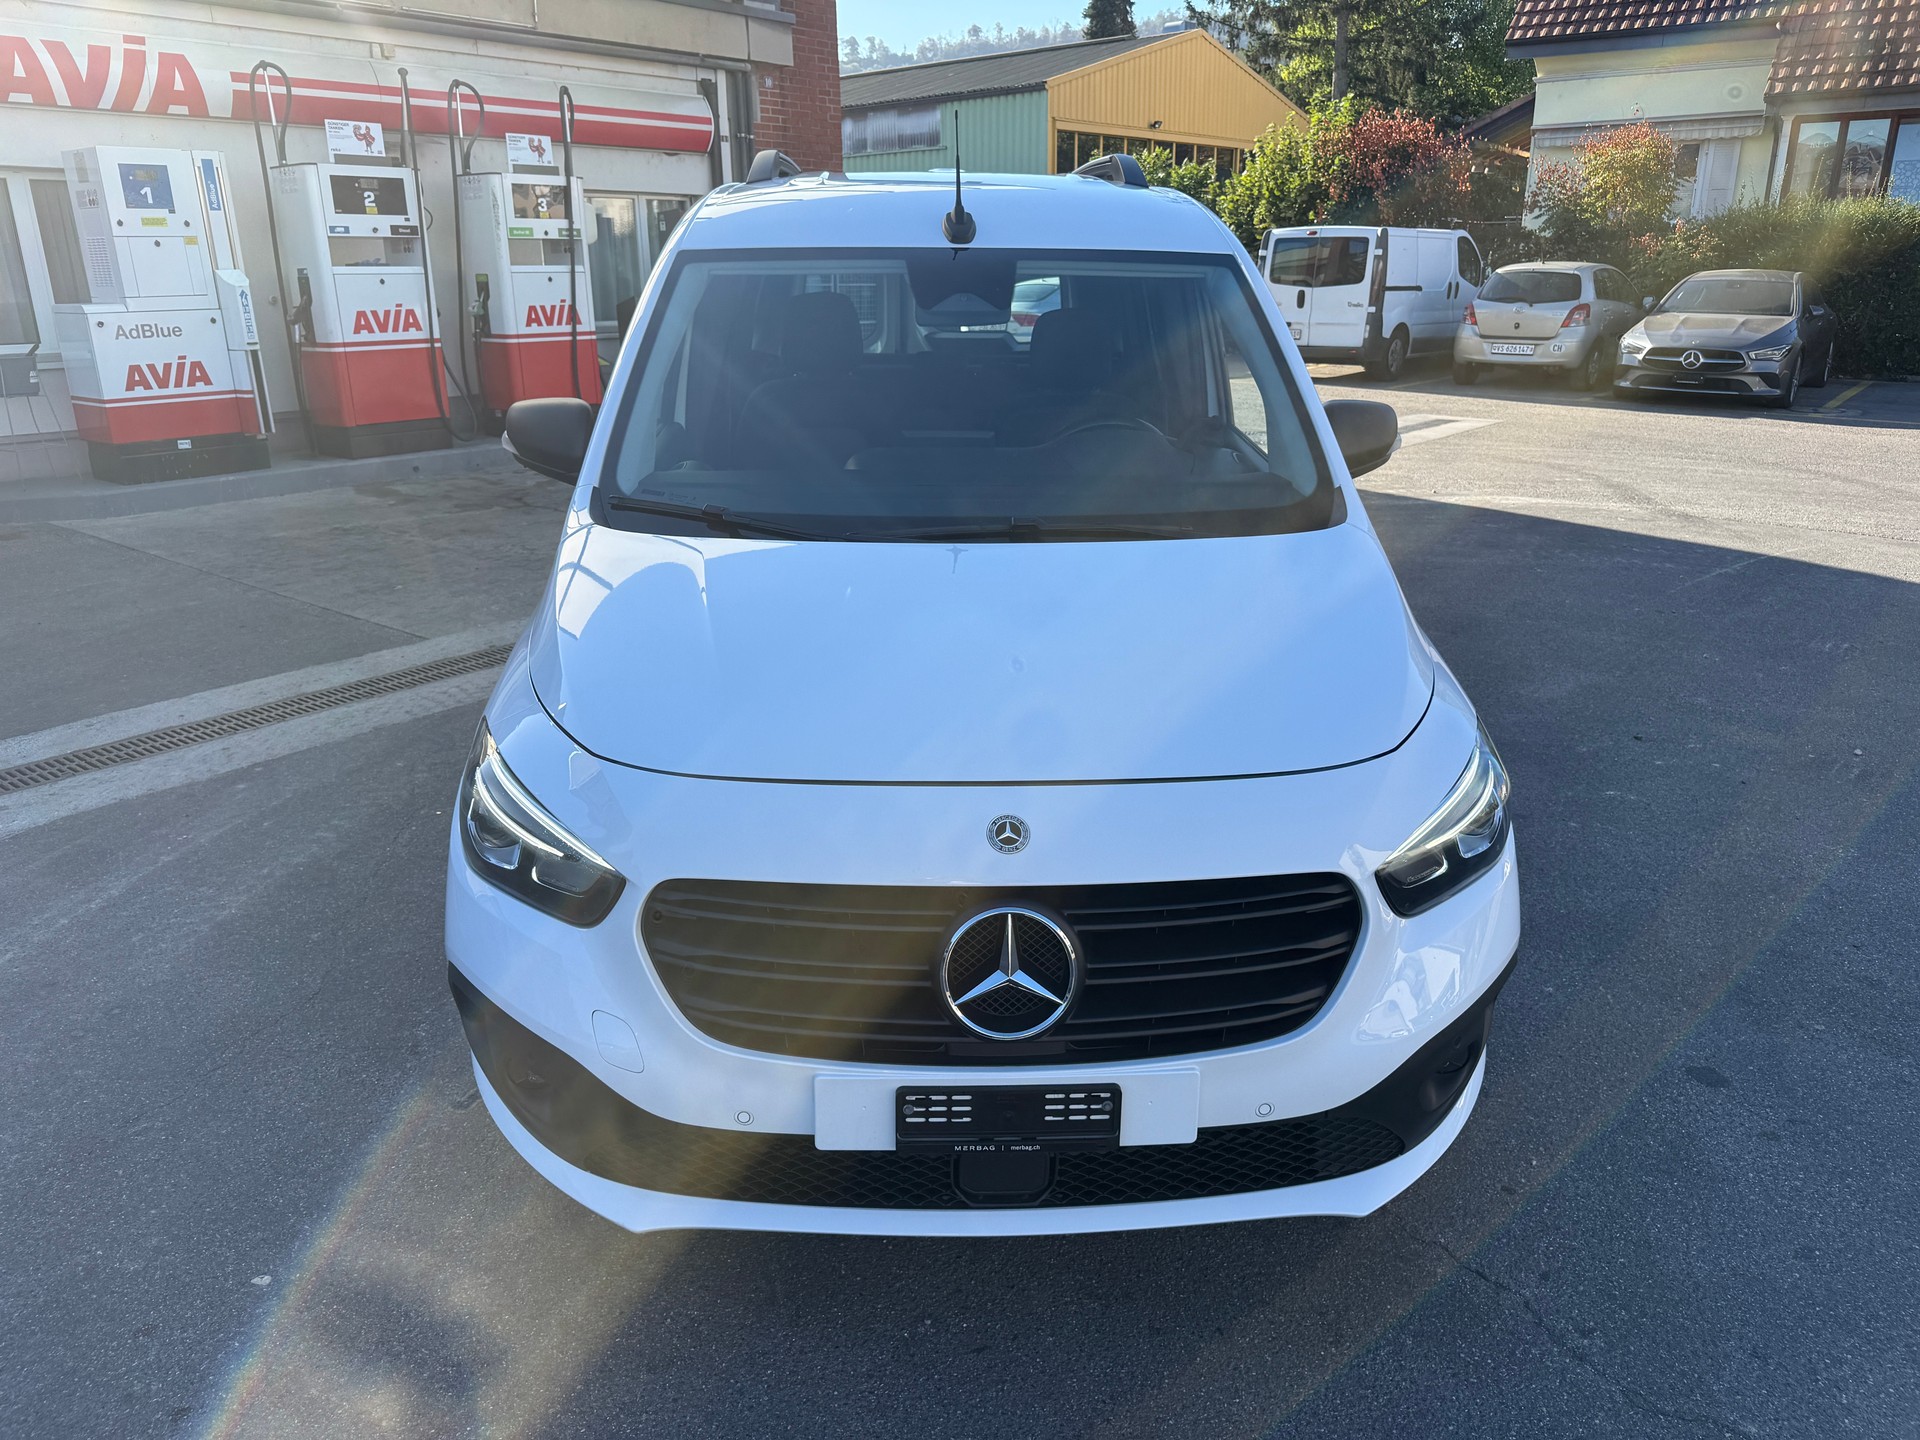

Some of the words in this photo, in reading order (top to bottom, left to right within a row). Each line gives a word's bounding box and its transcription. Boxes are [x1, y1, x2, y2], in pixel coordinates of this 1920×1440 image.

[140, 187, 153, 204] 1
[363, 191, 376, 207] 2
[537, 197, 548, 212] 3
[115, 323, 182, 340] AdBlue
[1552, 344, 1563, 352] CH
